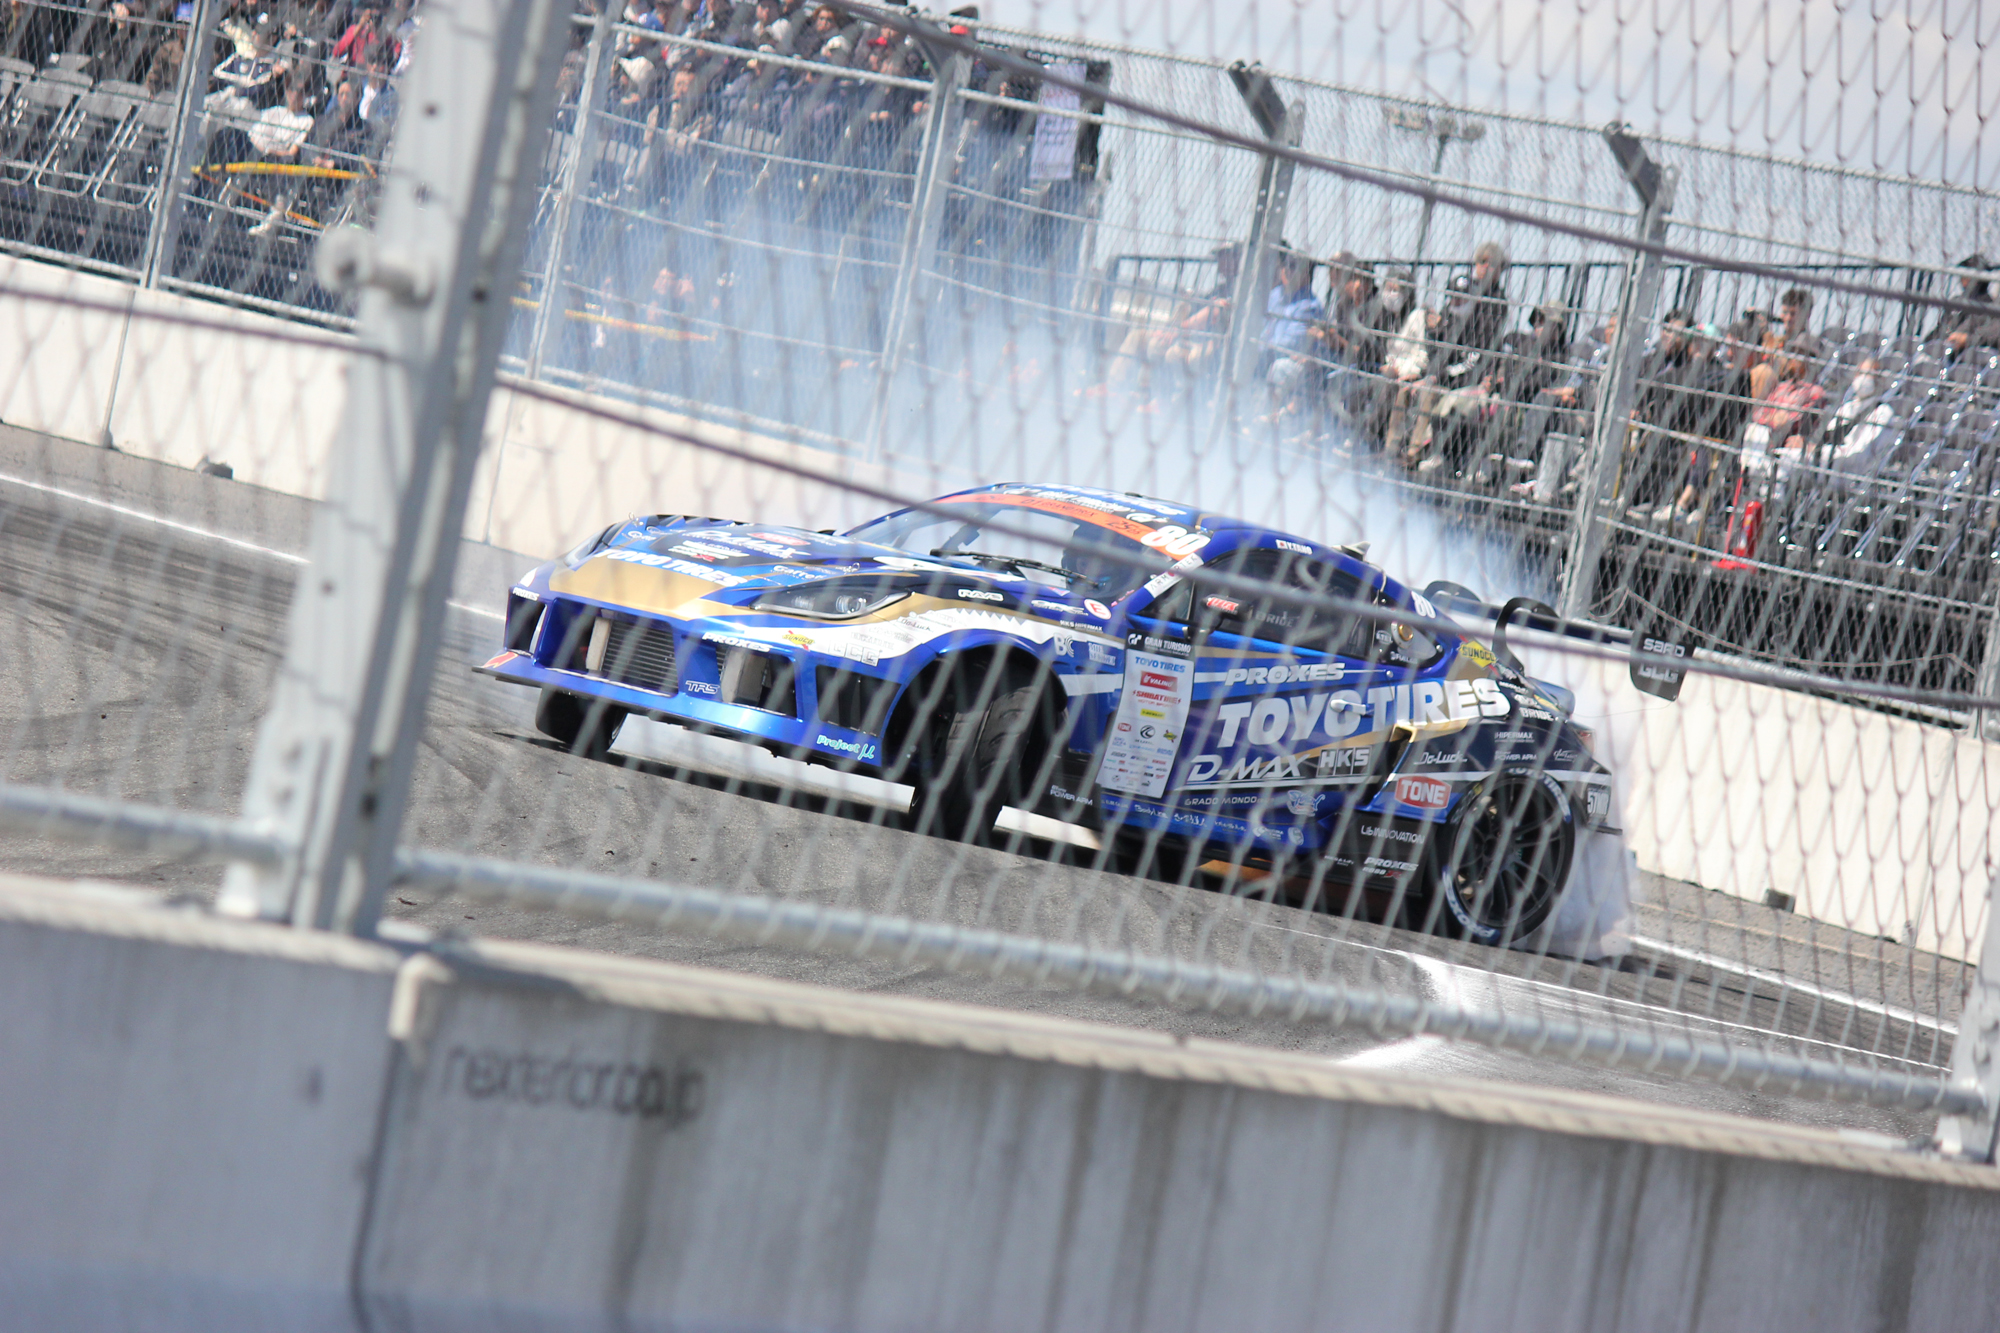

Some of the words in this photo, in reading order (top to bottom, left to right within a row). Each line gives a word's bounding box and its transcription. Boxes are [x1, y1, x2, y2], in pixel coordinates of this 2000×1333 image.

[1140, 525, 1211, 556] 80
[596, 548, 673, 566] TOYO
[661, 559, 749, 588] TIRES
[702, 632, 771, 653] PROXES
[782, 633, 815, 647] SUNOCO
[1144, 636, 1163, 649] GRAN
[1163, 640, 1192, 653] TURISMO
[1135, 656, 1159, 669] TOYO
[1159, 661, 1187, 674] TIRES
[1224, 662, 1346, 687] PROXES
[1217, 690, 1368, 749] TOYO
[1366, 677, 1511, 732] TIRES
[817, 734, 860, 753] Project
[1187, 752, 1312, 783] D-MAX
[1319, 748, 1370, 770] HKS
[1400, 779, 1446, 806] TONE
[1363, 856, 1419, 872] PROXES
